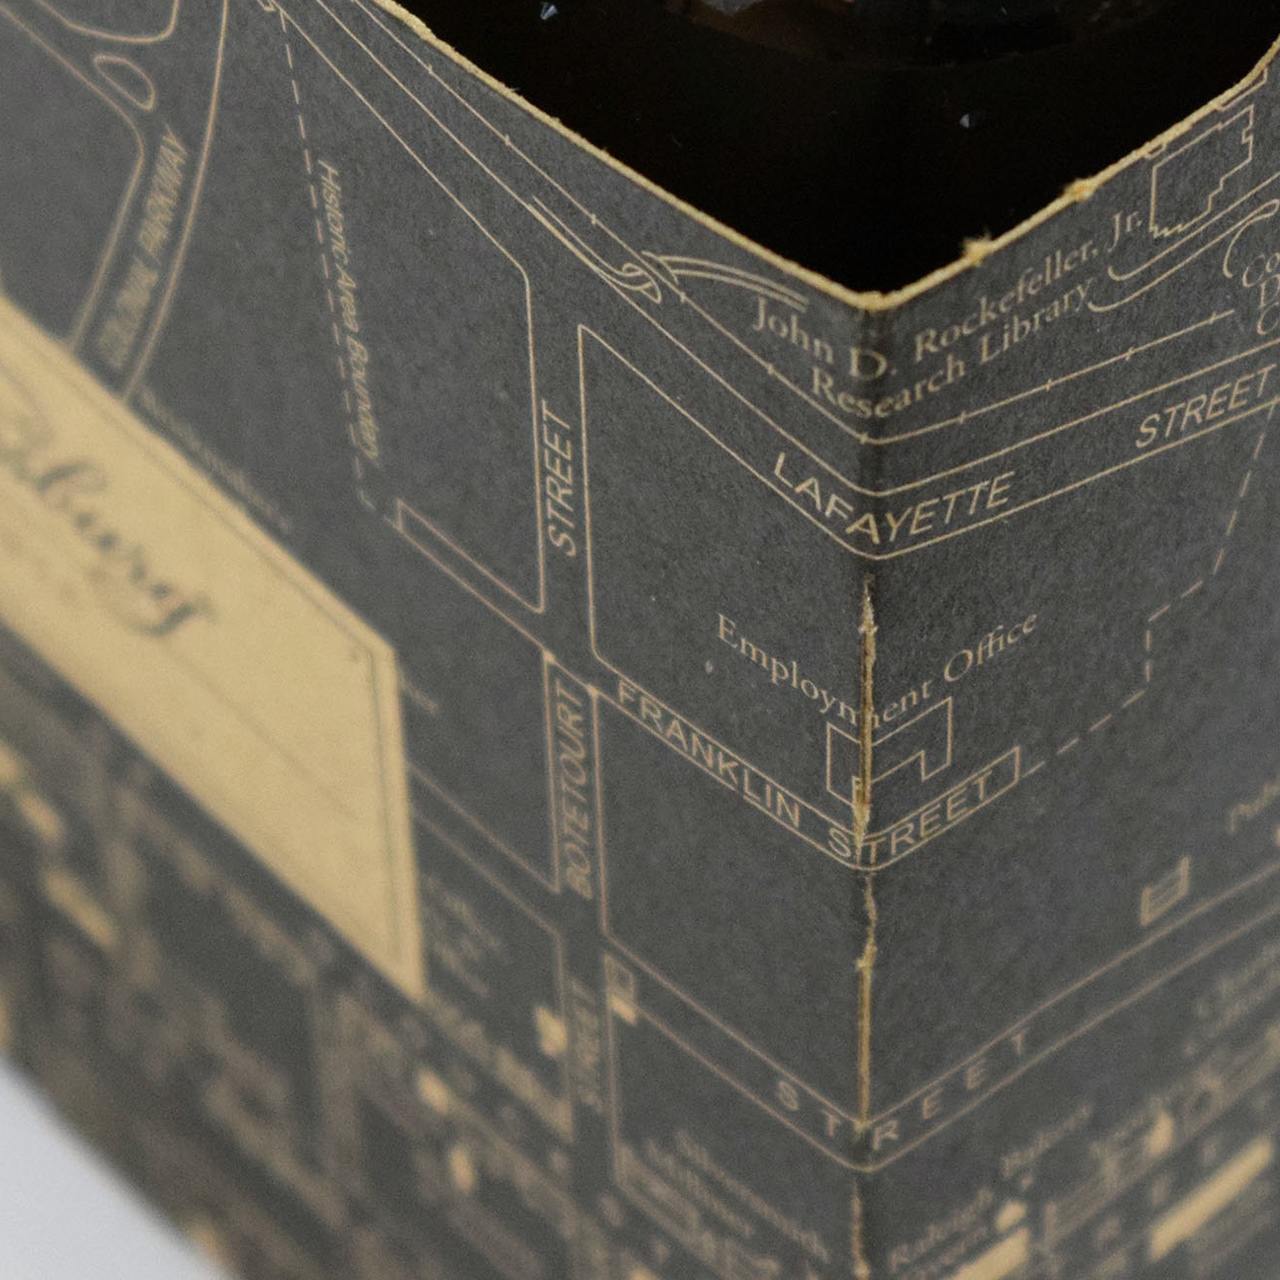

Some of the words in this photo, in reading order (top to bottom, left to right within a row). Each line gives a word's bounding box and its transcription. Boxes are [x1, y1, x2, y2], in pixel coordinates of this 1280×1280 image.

[137, 122, 189, 266] PARKWAY
[318, 159, 350, 266] Historic
[335, 262, 358, 334] Area
[751, 294, 834, 365] John
[850, 346, 897, 382] D.
[914, 241, 1099, 363] Rockefeller,
[1108, 212, 1142, 249] Jr.
[809, 357, 966, 420] Research
[979, 281, 1098, 365] Library
[346, 334, 380, 468] Boundary
[772, 451, 1016, 546] LAFAYETTE
[1135, 363, 1277, 448] STREET
[540, 399, 579, 556] STREET
[943, 610, 1039, 683] Office
[555, 679, 593, 903] BOTETOURT
[618, 678, 802, 827] FRANKLIN
[828, 772, 998, 864] STREET
